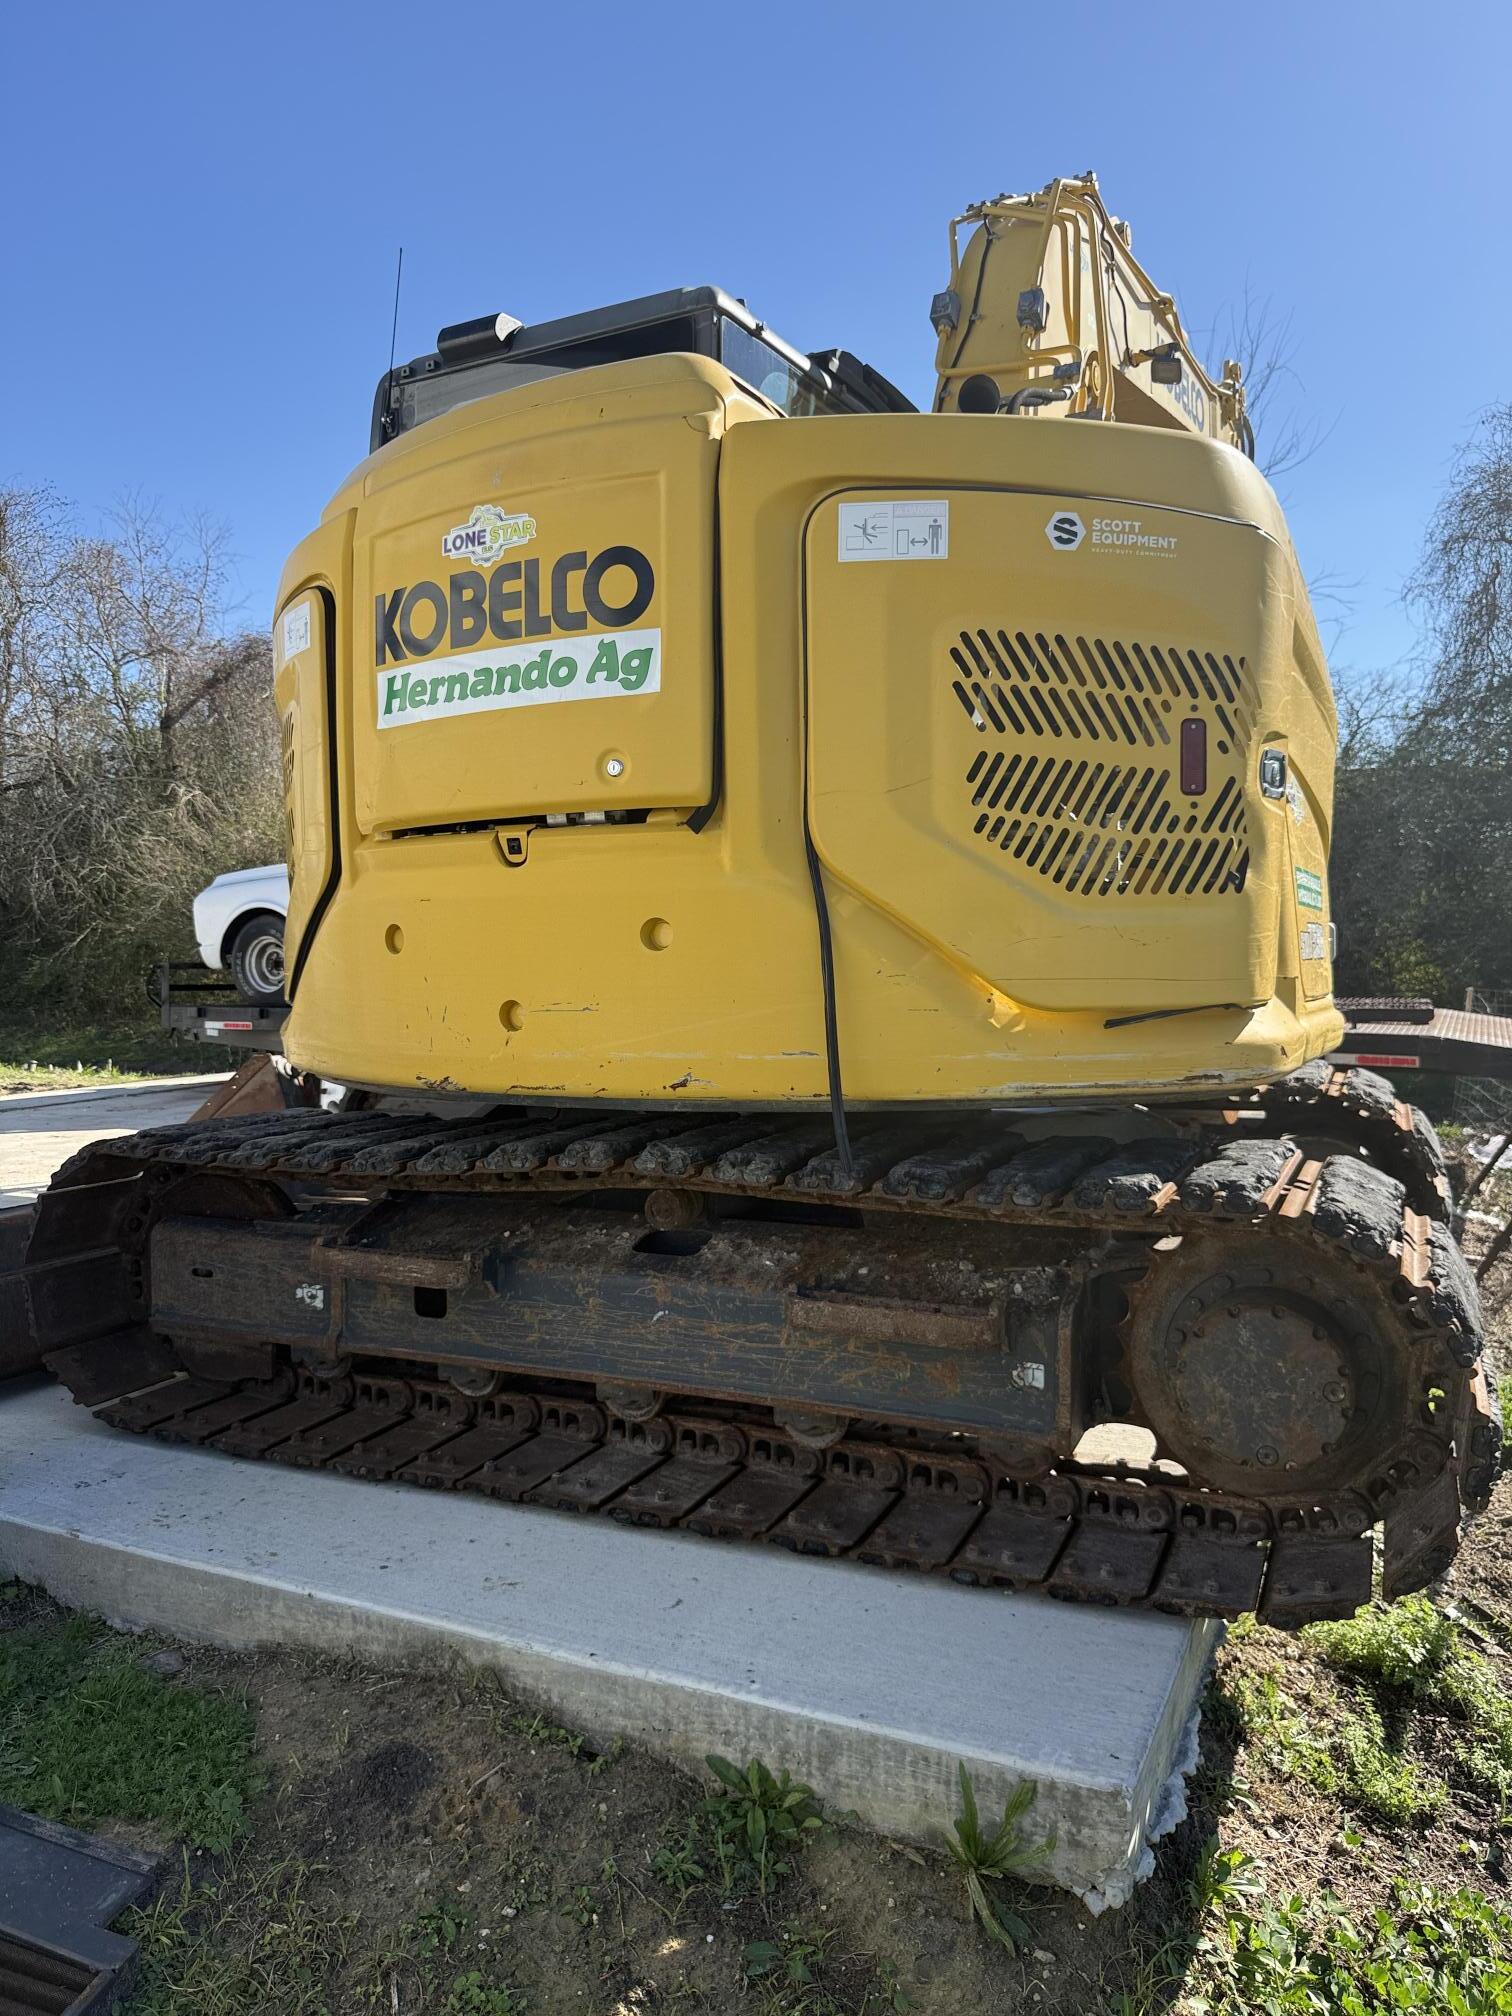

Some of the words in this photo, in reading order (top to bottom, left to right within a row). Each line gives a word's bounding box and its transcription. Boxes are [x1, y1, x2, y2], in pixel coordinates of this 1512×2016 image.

[442, 528, 487, 554] LONE
[488, 518, 535, 545] STAR
[1091, 517, 1142, 533] SCOTT
[1091, 531, 1178, 550] EQUIPMENT
[375, 545, 655, 667] KOBELCO
[383, 649, 578, 715] Hernando
[585, 638, 654, 691] Ag
